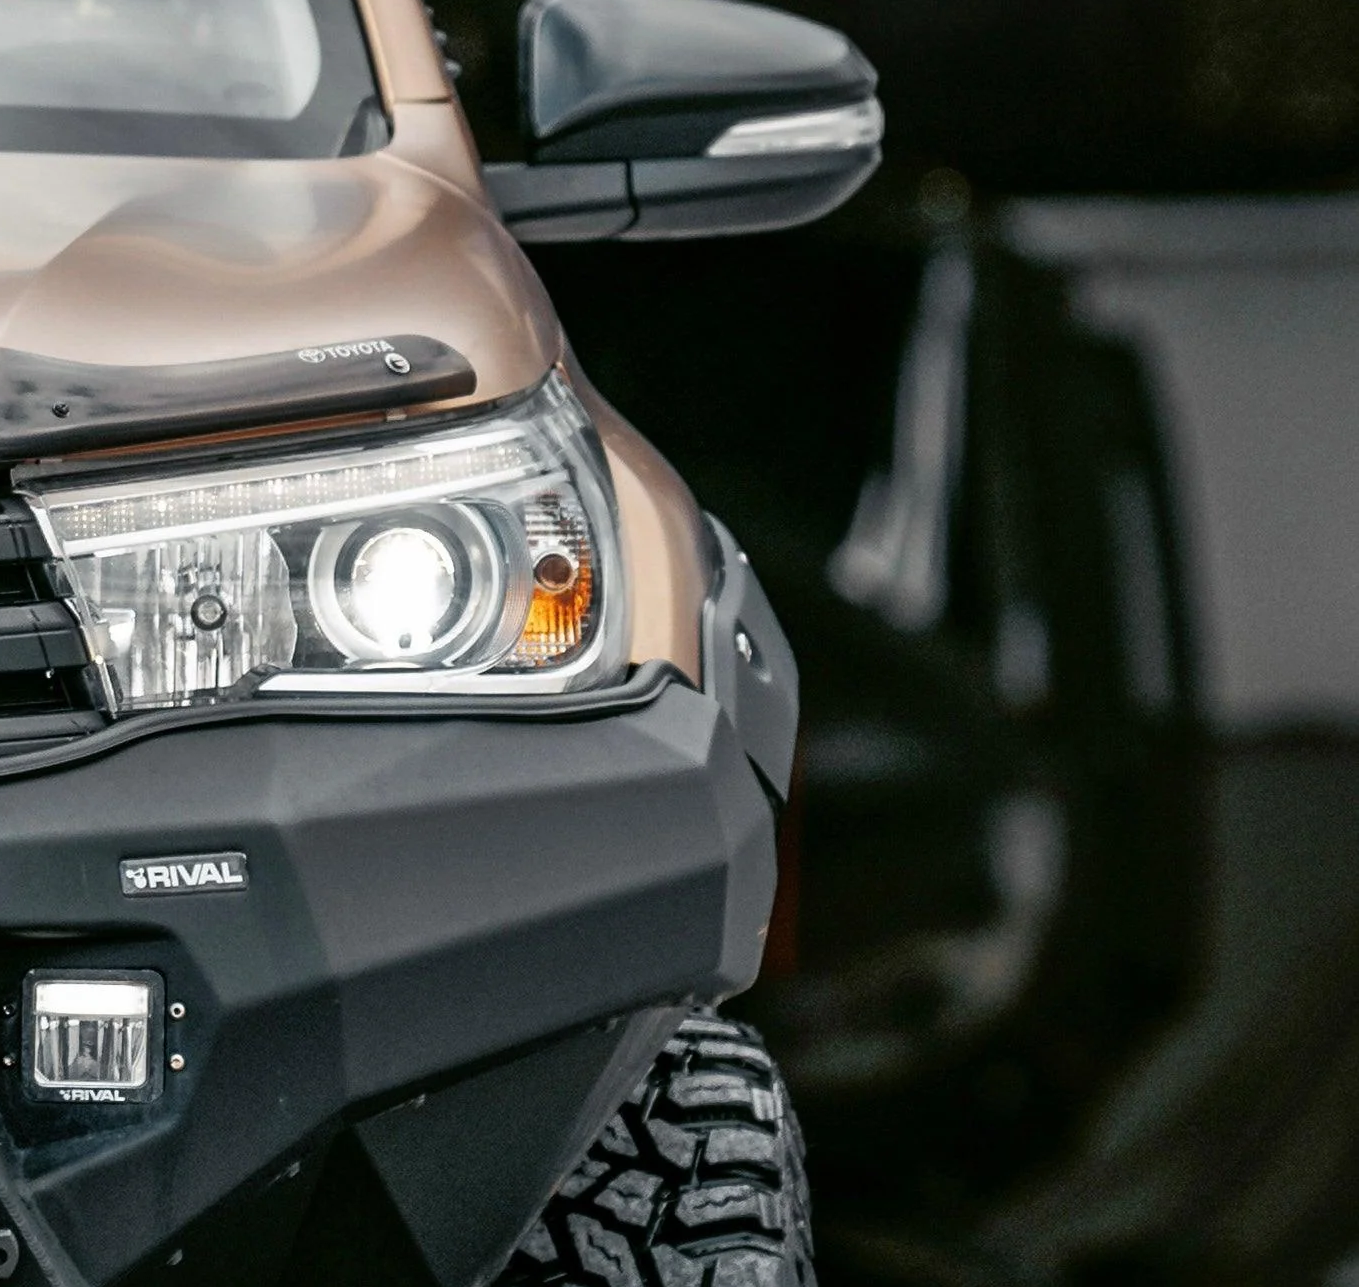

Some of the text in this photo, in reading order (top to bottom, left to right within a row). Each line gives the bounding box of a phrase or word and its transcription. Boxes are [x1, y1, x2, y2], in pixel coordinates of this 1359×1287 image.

[323, 339, 394, 358] TOYOTA
[146, 862, 244, 889] RIVAL
[71, 1089, 126, 1102] RIVAL
